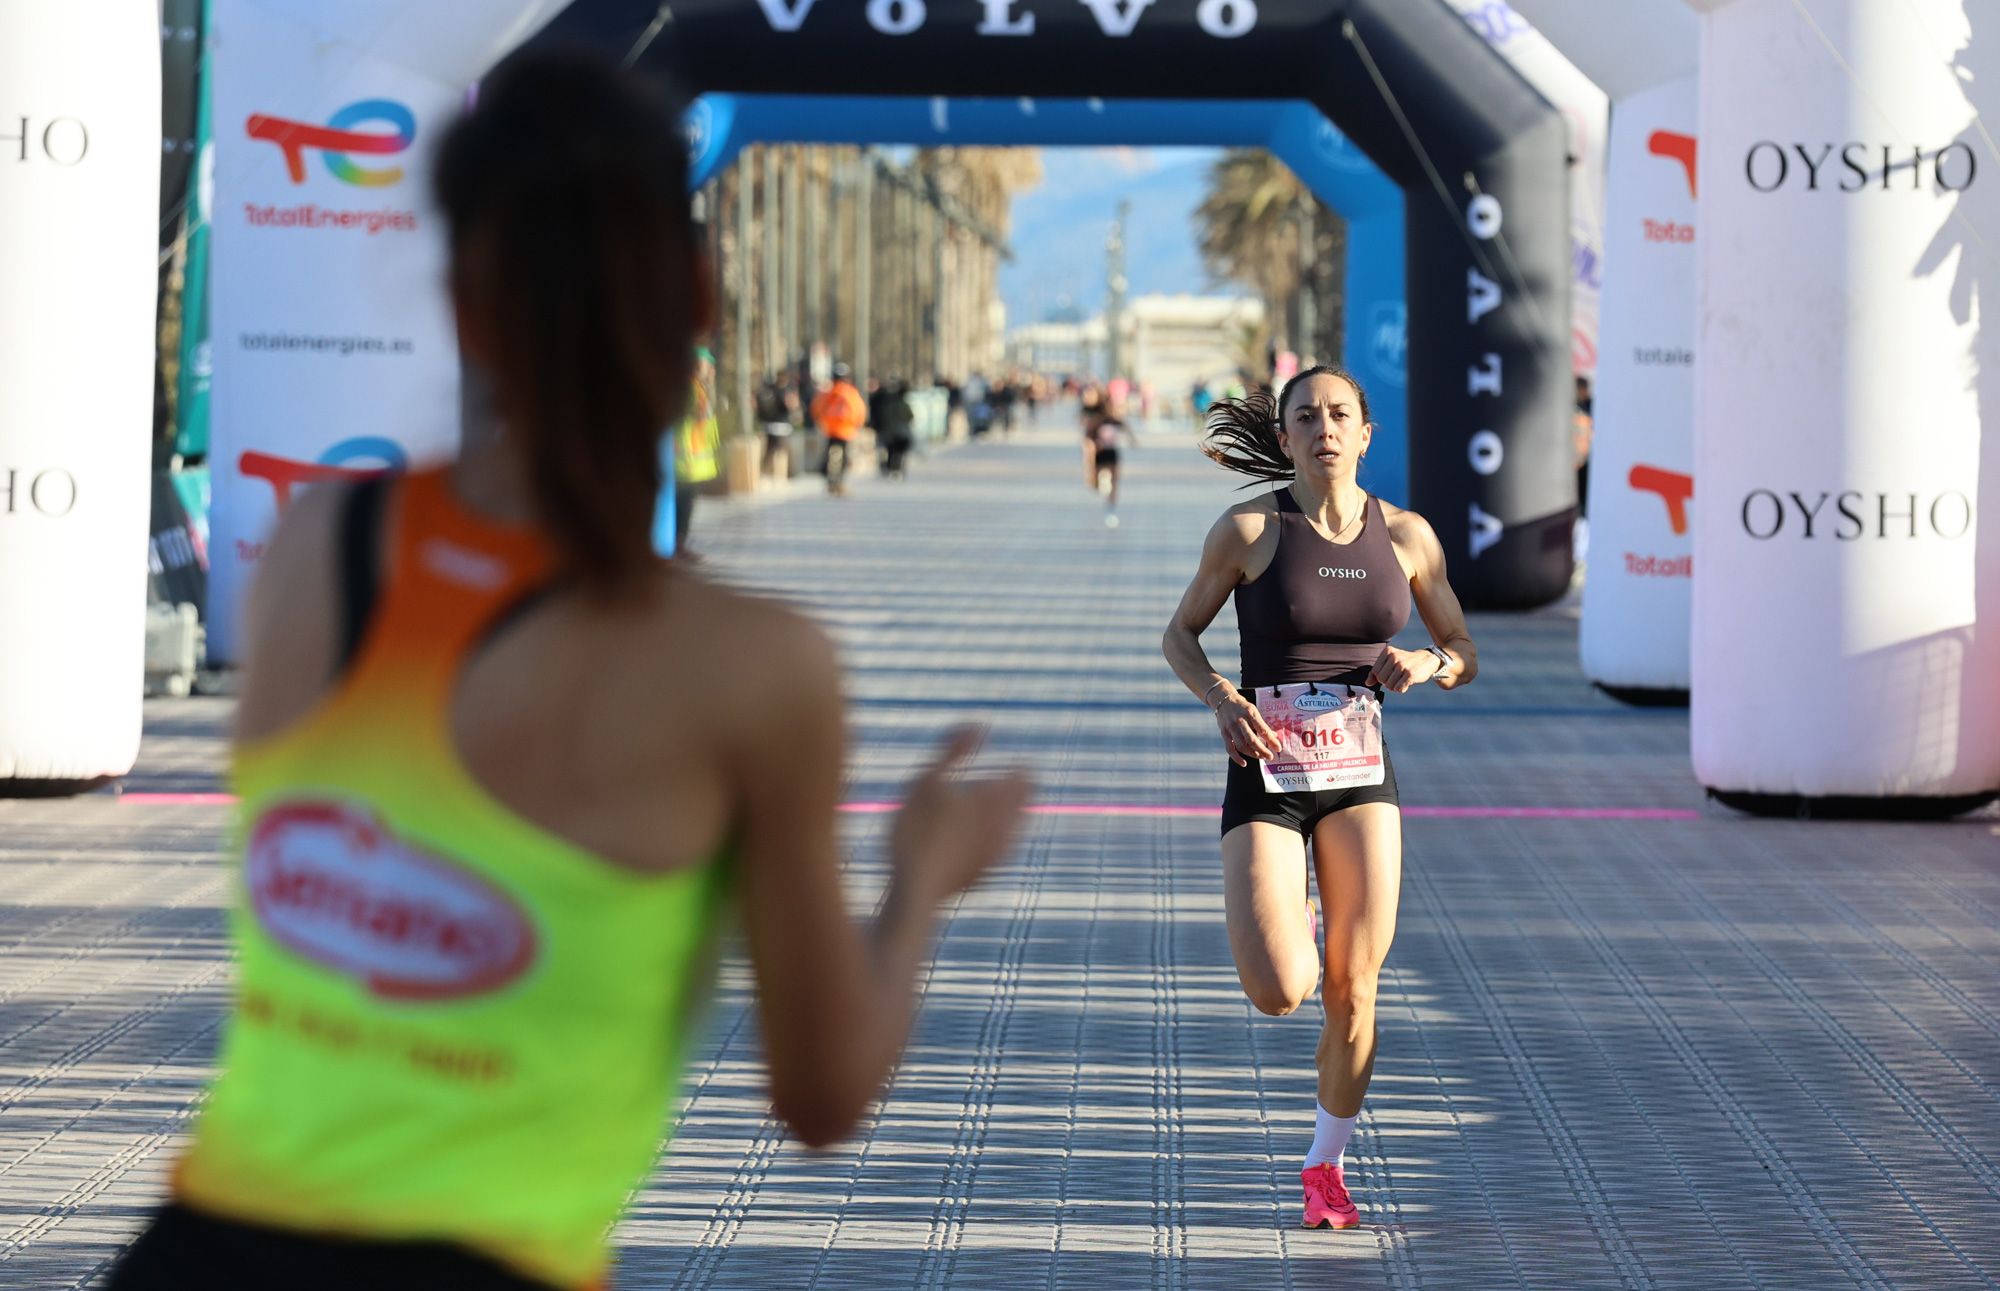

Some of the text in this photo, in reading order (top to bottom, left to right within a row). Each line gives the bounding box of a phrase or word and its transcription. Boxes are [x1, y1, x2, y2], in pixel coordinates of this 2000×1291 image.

[756, 0, 1258, 38] VOLVO
[1745, 140, 1978, 193] OYSHO
[243, 203, 419, 236] TotalEnergies
[1467, 193, 1503, 560] VOLVO
[1741, 488, 1972, 540] OYSHO
[1318, 566, 1367, 580] OYSHO
[1265, 703, 1289, 712] SUMA
[1297, 699, 1339, 708] ASTURIANA
[1301, 728, 1345, 748] 016
[1314, 751, 1330, 761] 117
[1277, 764, 1302, 772] CARRERA
[1303, 763, 1311, 771] DE
[1277, 776, 1314, 787] OYSHO
[1335, 772, 1371, 783] Santander
